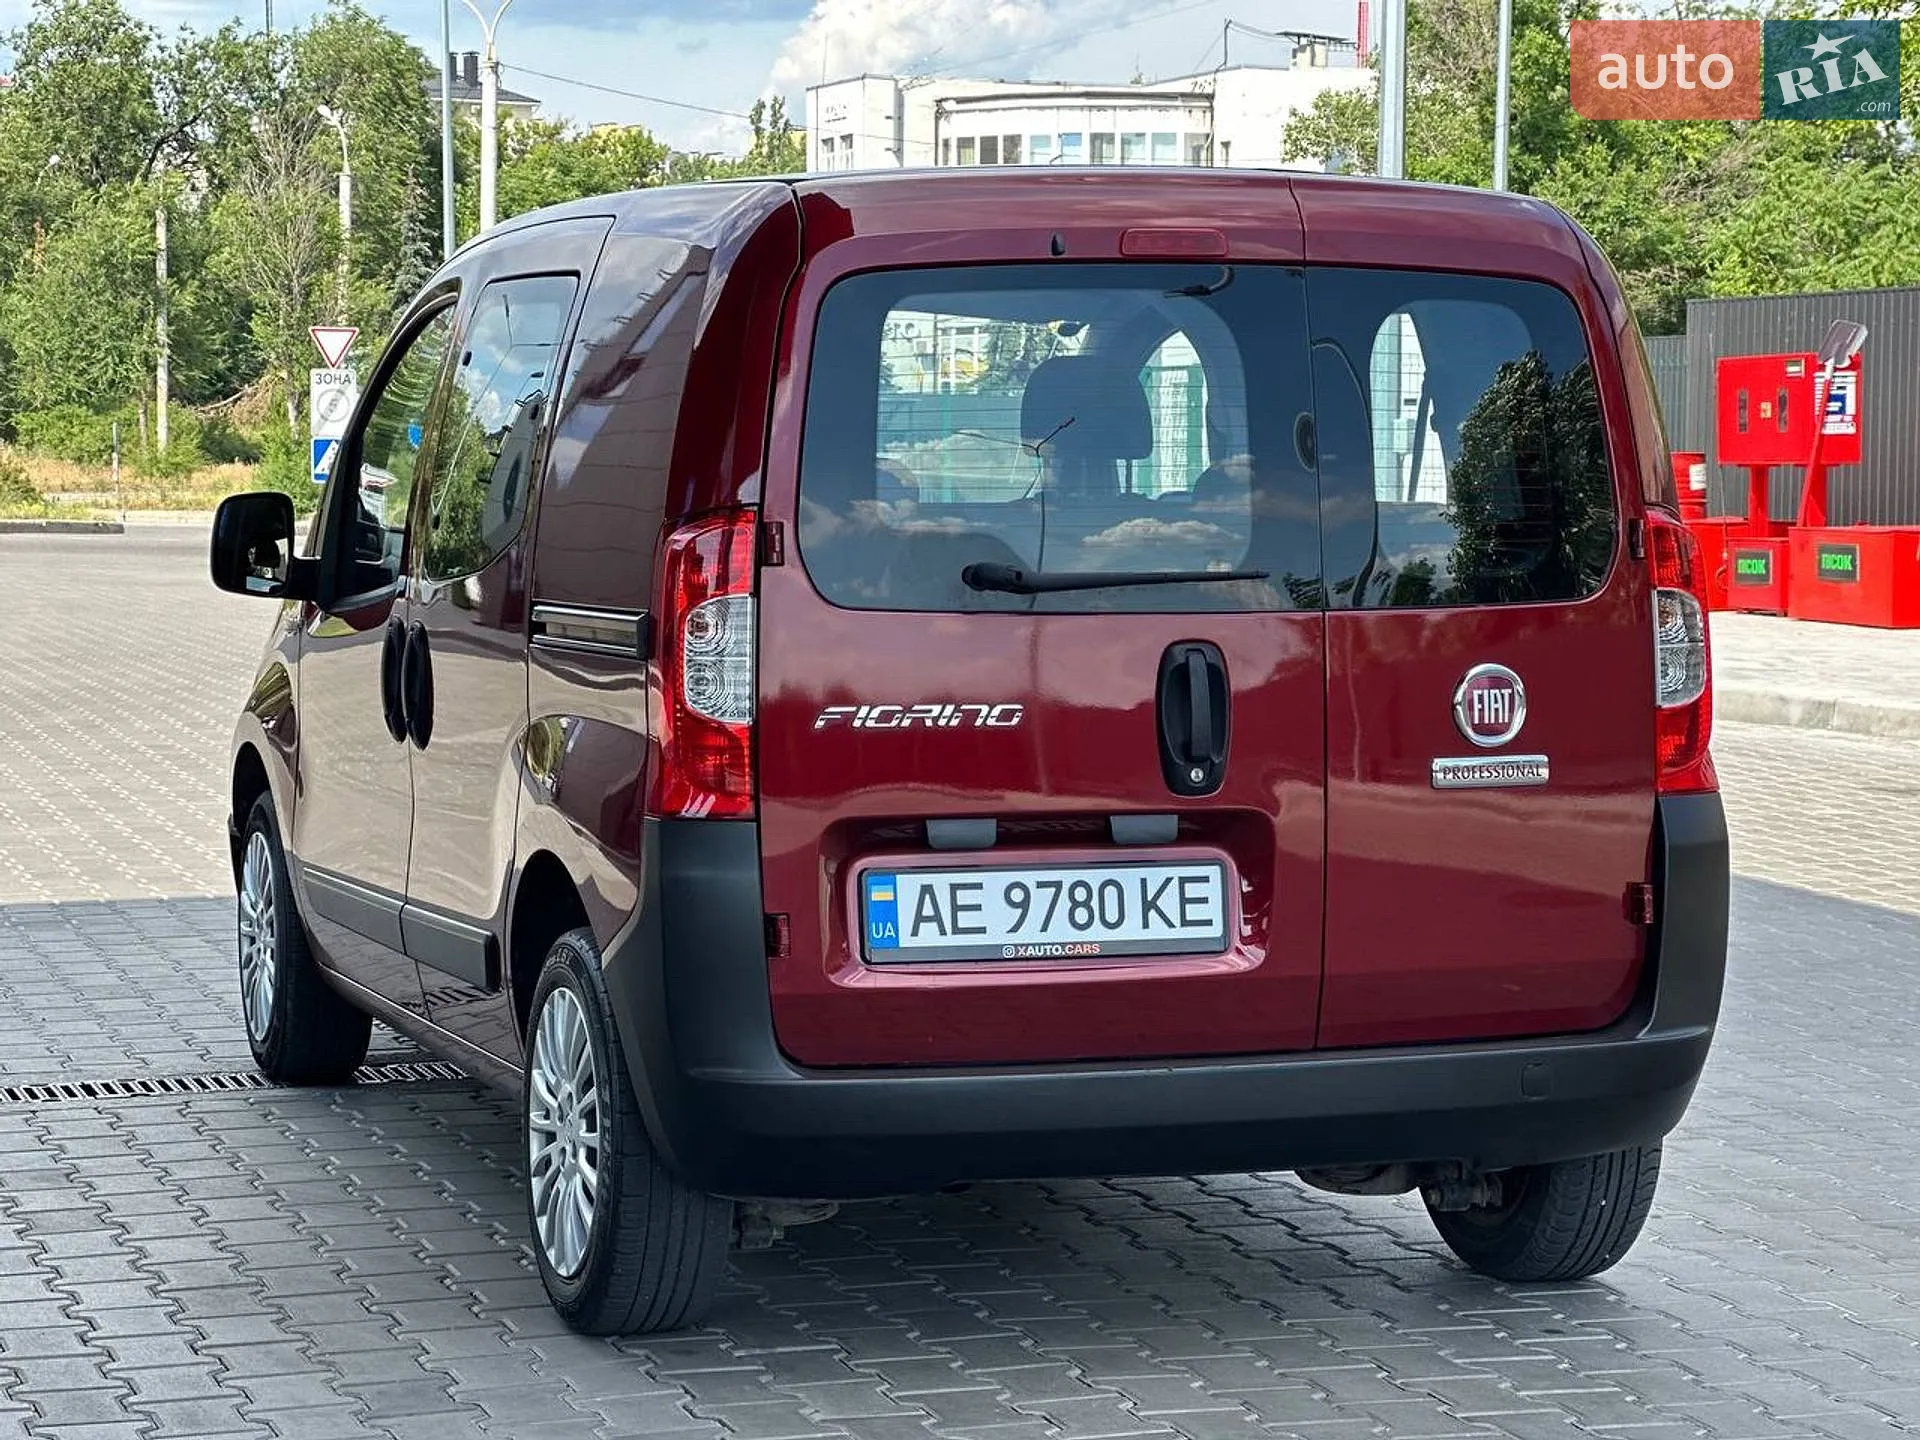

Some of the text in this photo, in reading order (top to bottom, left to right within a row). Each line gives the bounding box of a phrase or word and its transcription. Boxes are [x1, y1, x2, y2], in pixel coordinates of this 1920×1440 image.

[315, 373, 352, 385] ЗОНА
[1473, 688, 1512, 724] FIAT
[814, 704, 1024, 729] FIORINO
[1443, 763, 1543, 780] PROFESSIONAL
[910, 875, 1214, 937] AE 9780 KE
[872, 921, 896, 939] UA
[1018, 943, 1101, 956] XAUTO.CARS
